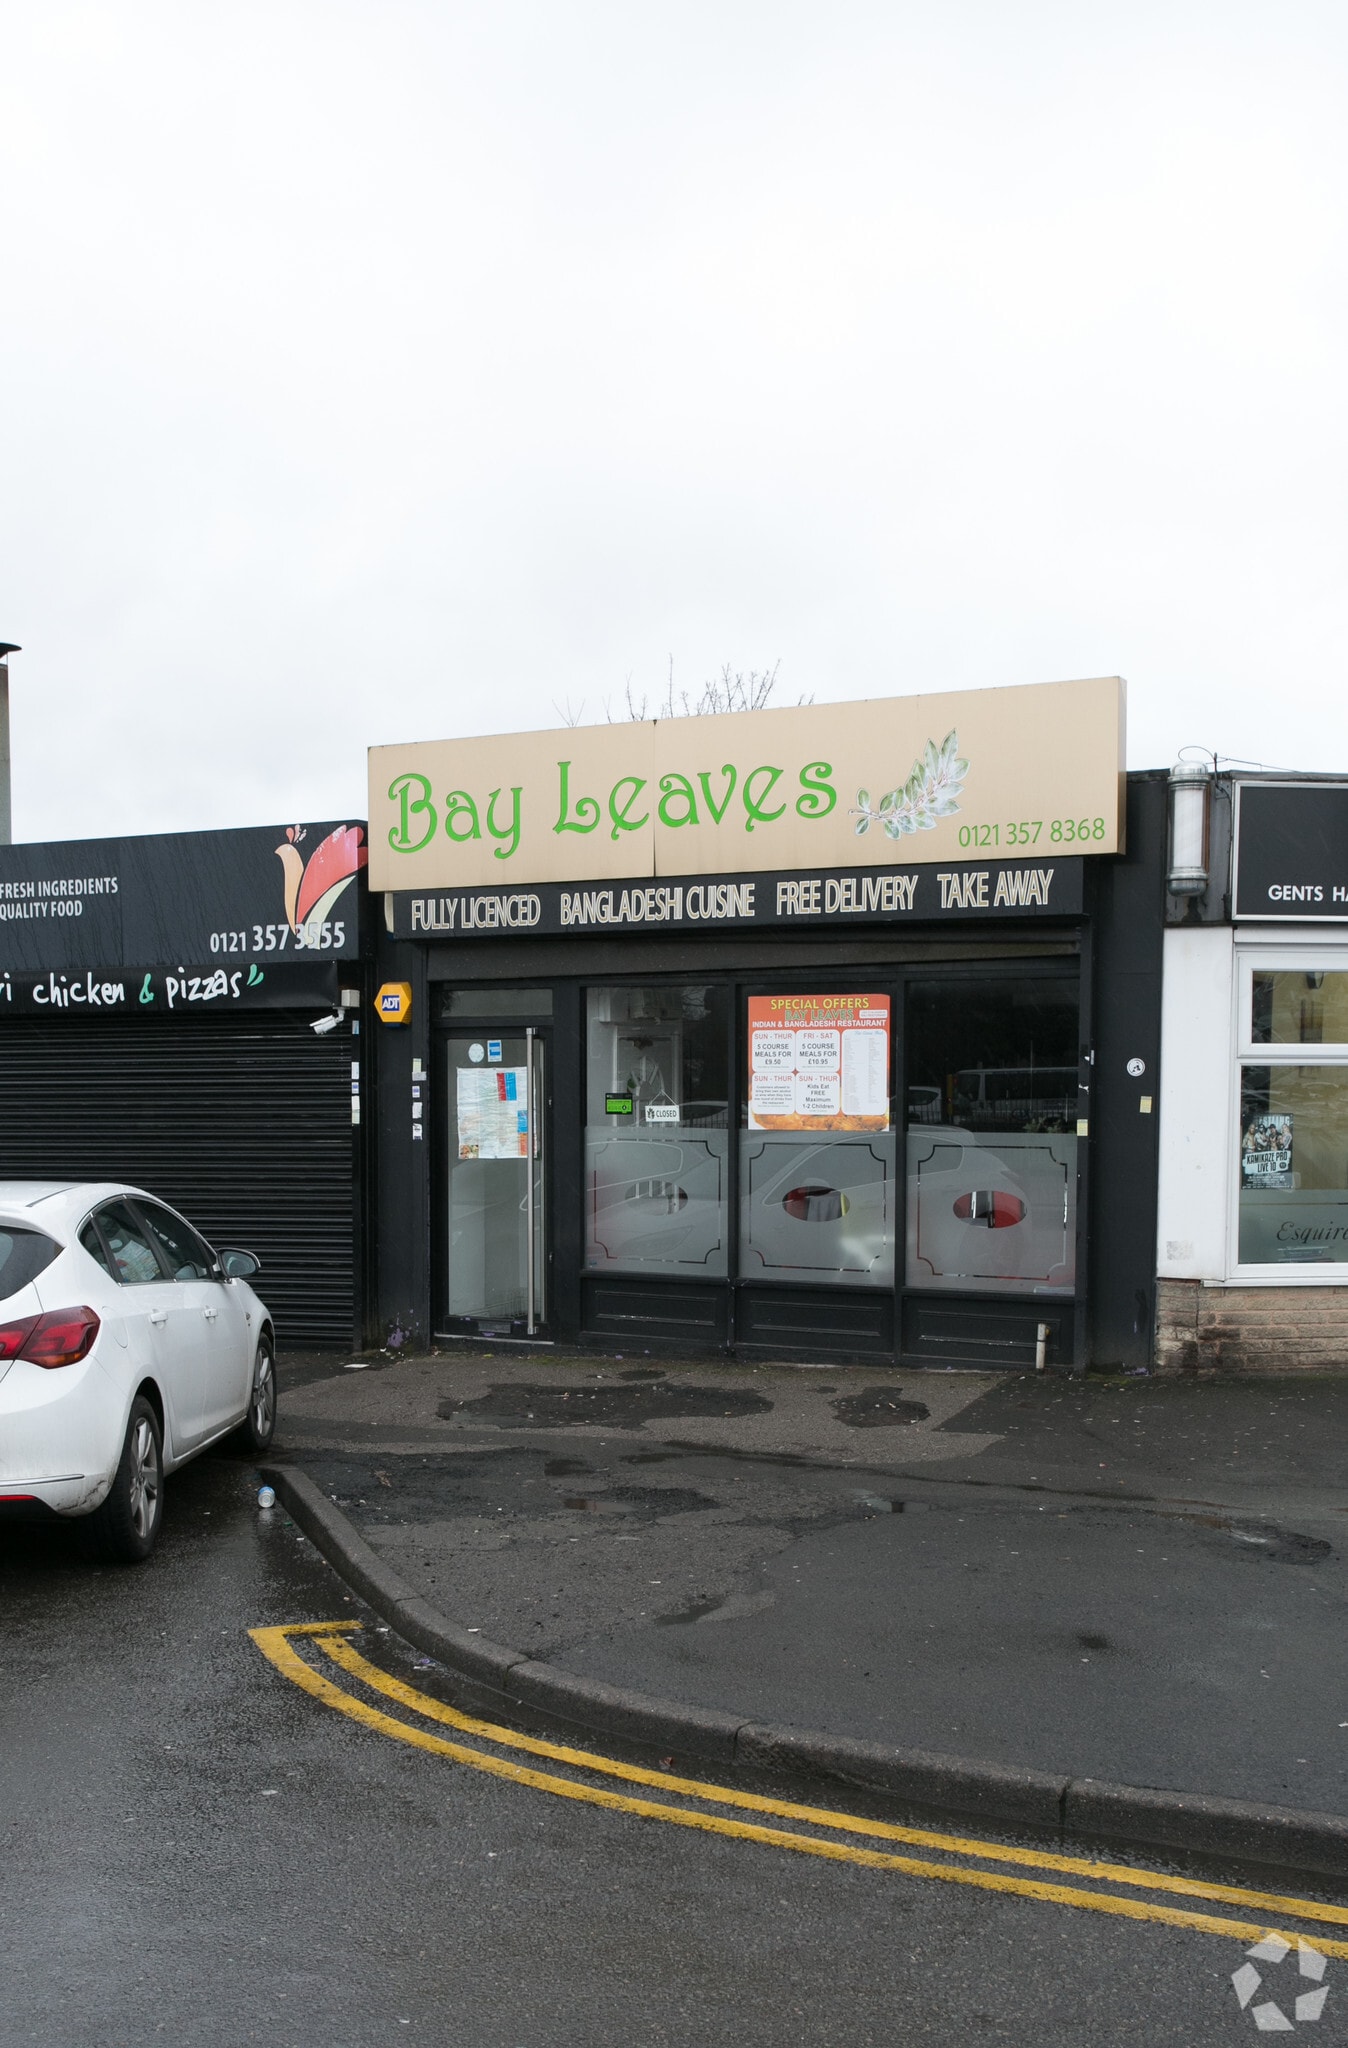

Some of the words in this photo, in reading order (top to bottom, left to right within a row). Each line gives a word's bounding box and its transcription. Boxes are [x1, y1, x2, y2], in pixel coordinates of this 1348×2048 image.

[388, 773, 523, 859] Bay
[552, 761, 837, 840] Leaves
[958, 824, 999, 847] 0121
[1006, 821, 1043, 845] 357
[1050, 817, 1105, 842] 8368
[0, 882, 34, 900] FRESH
[38, 877, 118, 897] INGREDIENTS
[1268, 884, 1324, 902] GENTS
[1332, 886, 1348, 902] H
[411, 899, 458, 930] FULLY
[461, 894, 541, 929] LICENCED
[560, 887, 682, 925] BANGLADESHI
[686, 883, 755, 920] CUISINE
[776, 879, 821, 915] FREE
[825, 875, 918, 913] DELIVERY
[937, 872, 989, 908] TAKE
[993, 869, 1054, 907] AWAY
[0, 902, 48, 921] QUALITY
[51, 900, 83, 918] FOOD
[210, 932, 246, 953] 0121
[252, 924, 289, 951] 357
[294, 921, 345, 950] 3555
[33, 972, 125, 1007] chicken
[165, 966, 242, 1008] pizzas
[382, 997, 400, 1010] ADT
[770, 998, 819, 1010] SPECIAL
[823, 997, 870, 1009] OFFERS
[784, 1020, 836, 1028] BANGLADESHI
[838, 1019, 886, 1027] RESTAURANT
[785, 1009, 808, 1021] BAY
[811, 1009, 854, 1021] LEAVES
[656, 1109, 677, 1118] CLOSED
[1247, 1152, 1275, 1164] KAMKAZE
[1258, 1163, 1268, 1172] LIVE
